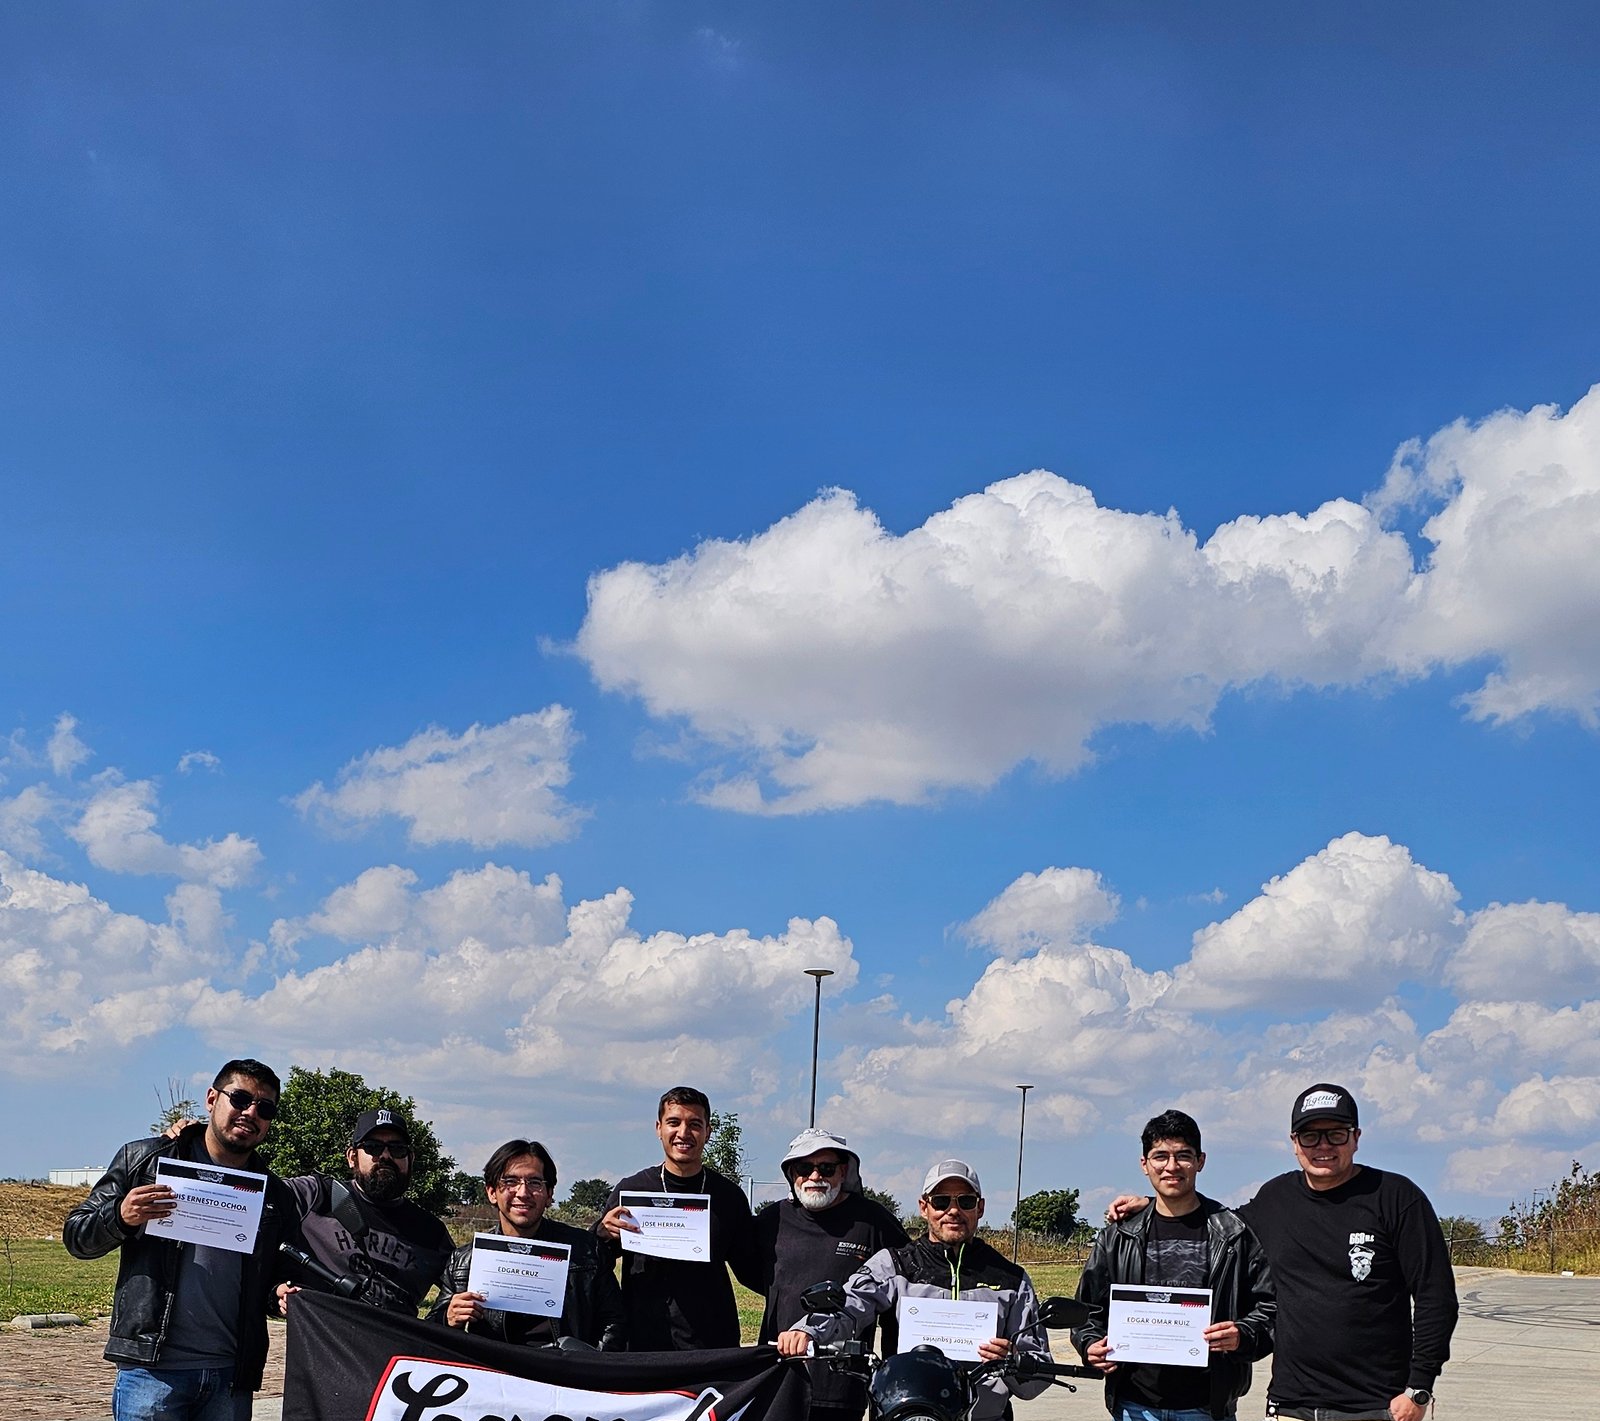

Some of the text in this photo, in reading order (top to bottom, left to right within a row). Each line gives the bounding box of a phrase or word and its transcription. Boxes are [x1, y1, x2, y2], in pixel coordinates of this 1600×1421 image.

[186, 1195, 220, 1207] ERNESTO
[220, 1200, 247, 1212] OCHOA
[334, 1229, 418, 1269] HRLEY
[497, 1266, 539, 1277] EDGAR CRUZ
[1127, 1316, 1150, 1324] EDGAR
